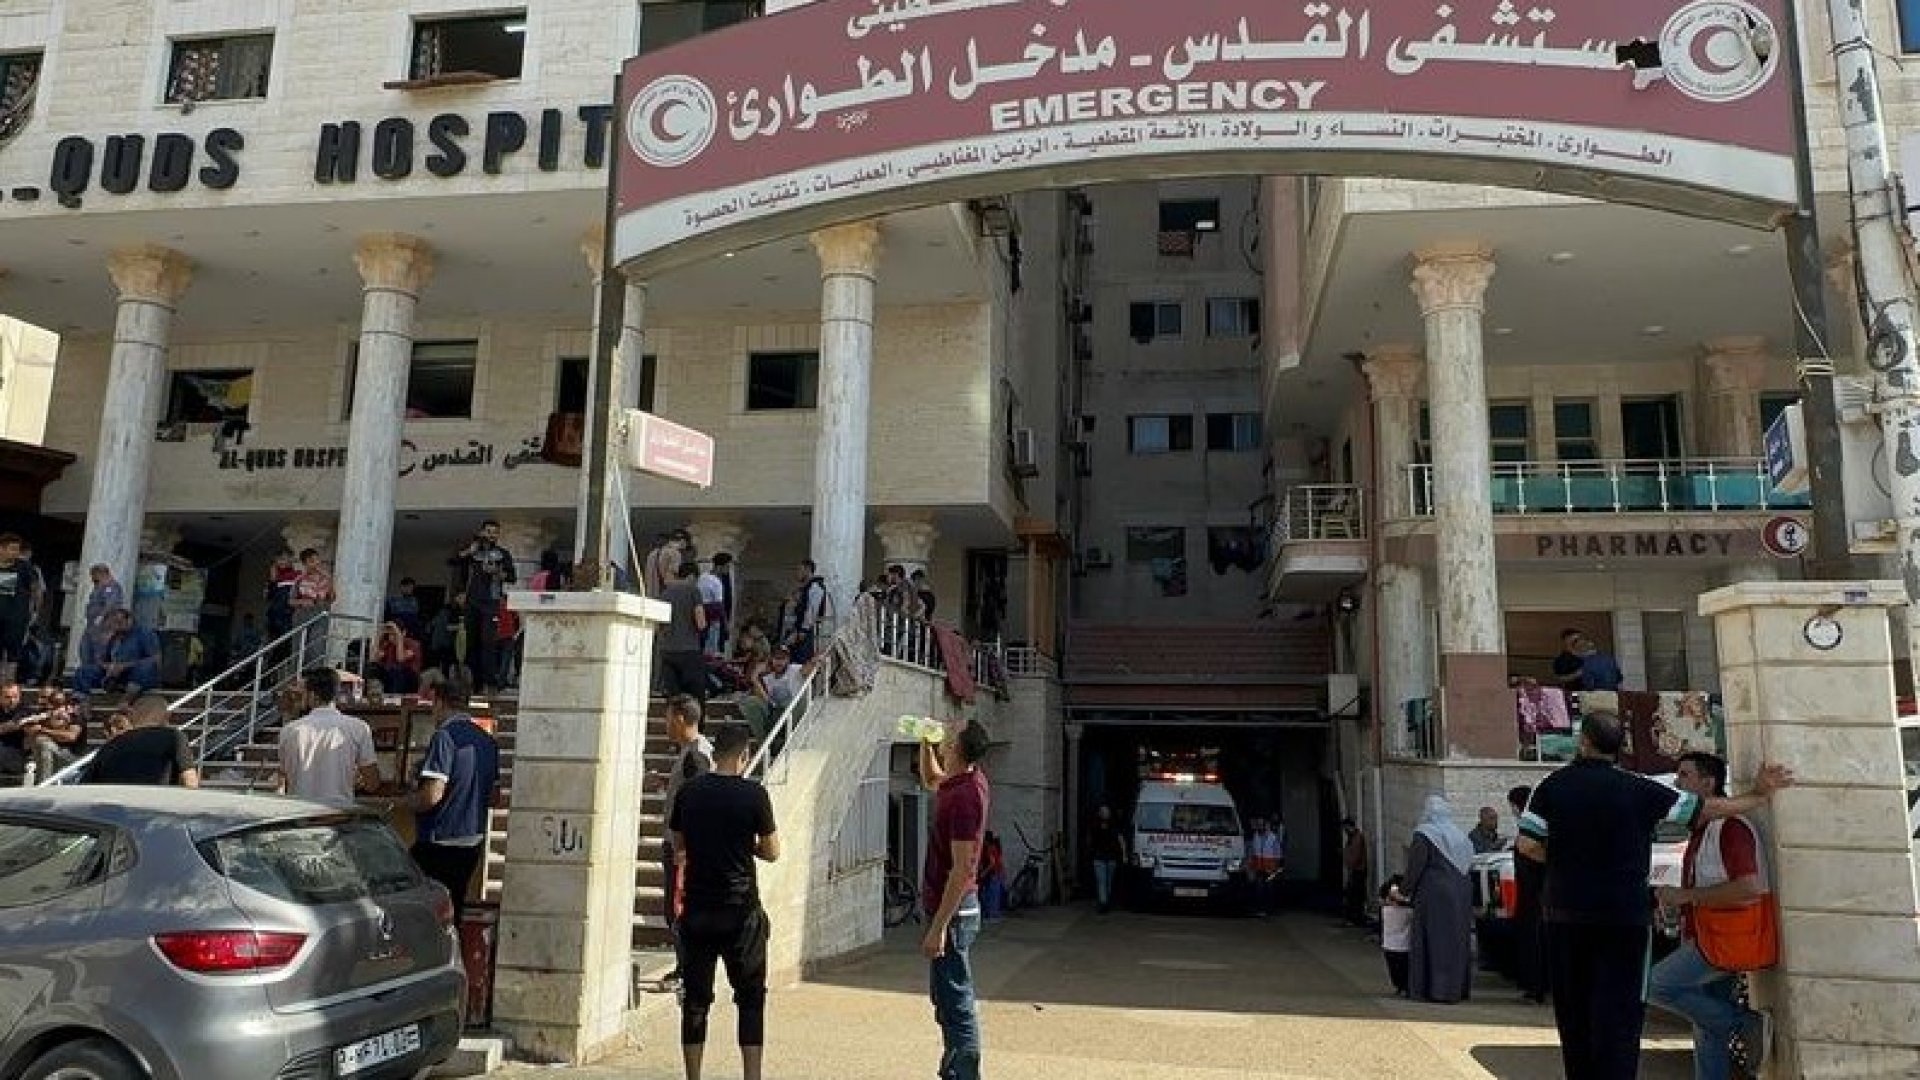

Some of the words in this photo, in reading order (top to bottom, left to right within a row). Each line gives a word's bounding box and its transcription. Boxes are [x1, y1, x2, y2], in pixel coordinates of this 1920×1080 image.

[950, 22, 1117, 100] مدخل
[1164, 2, 1370, 80] القدس
[1386, 0, 1663, 90] ستشفى
[726, 45, 933, 140] الطوارئ
[990, 79, 1327, 131] EMERGENCY
[1330, 117, 1414, 137] النساء
[1429, 117, 1544, 148] المختبرات
[0, 128, 245, 209] -QUDS
[314, 105, 615, 184] HOSPIT
[814, 160, 892, 193] العمليات
[422, 439, 493, 471] القدس
[1537, 532, 1734, 557] PHARMACY
